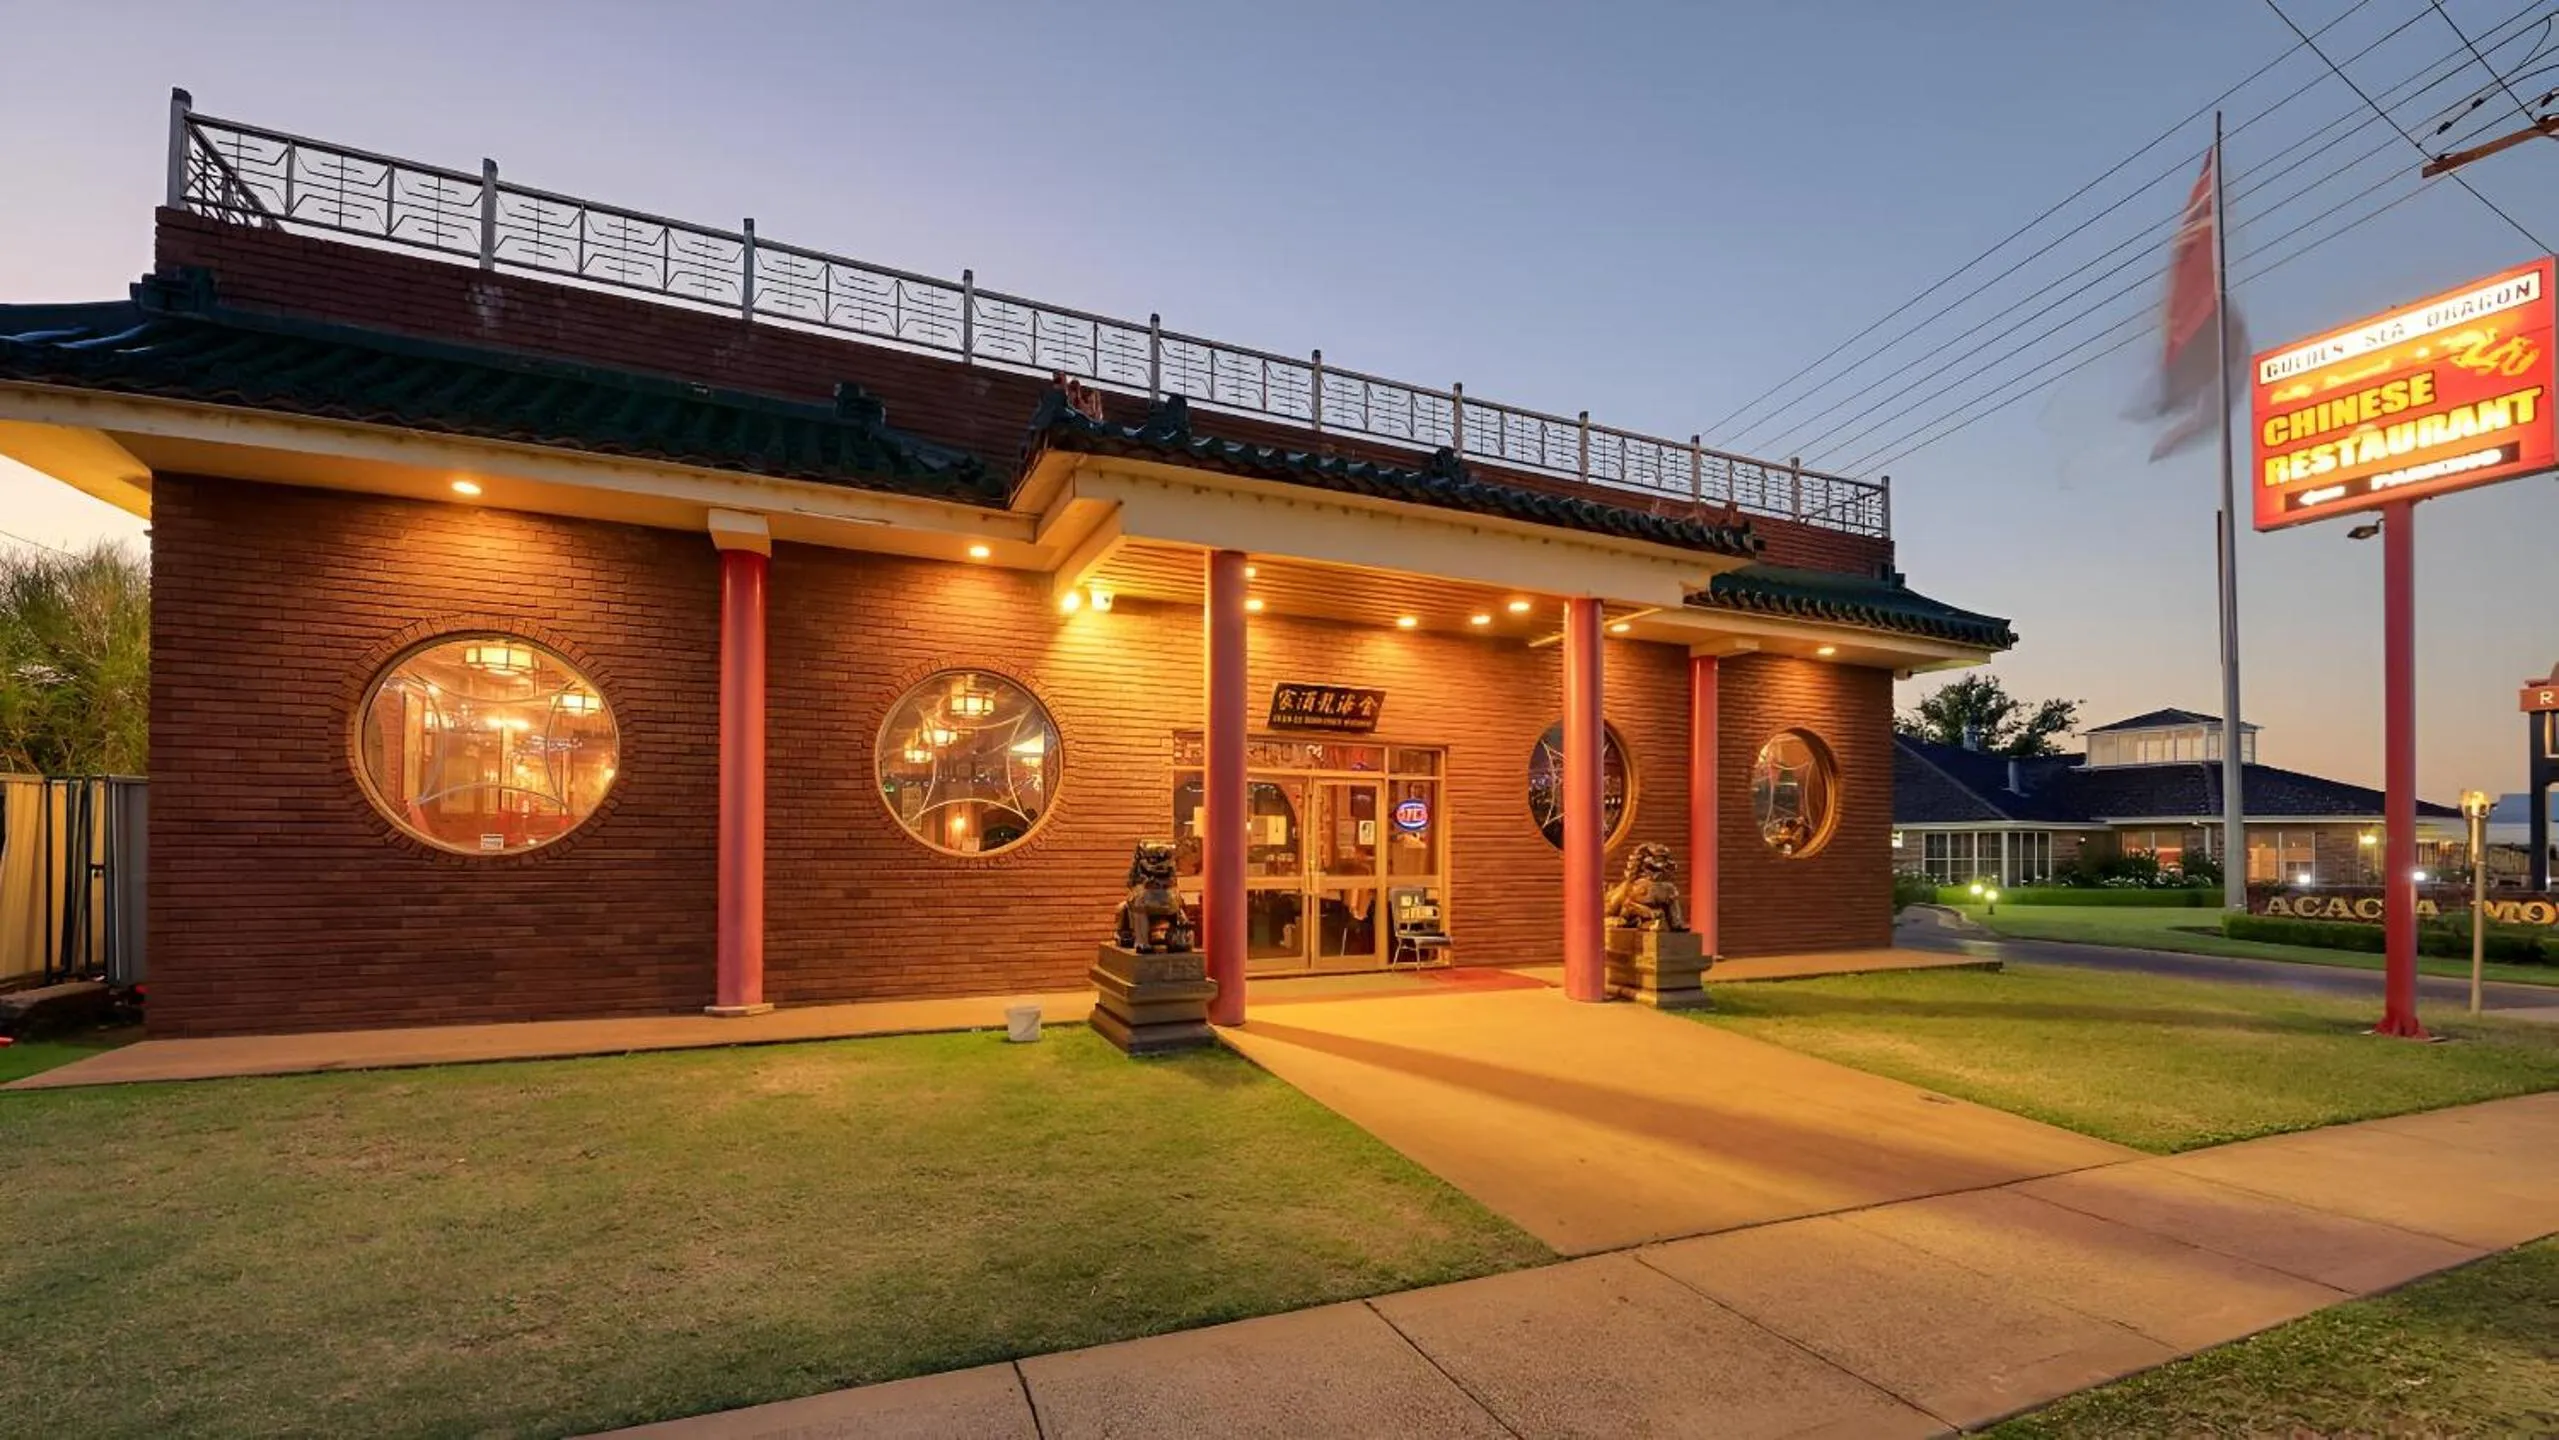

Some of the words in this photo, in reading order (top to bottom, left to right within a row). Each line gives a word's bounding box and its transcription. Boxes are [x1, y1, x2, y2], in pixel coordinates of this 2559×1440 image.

[2263, 370, 2436, 447] CHINESE
[2264, 385, 2545, 487] RESTAURANT
[2264, 895, 2441, 919] ACACA
